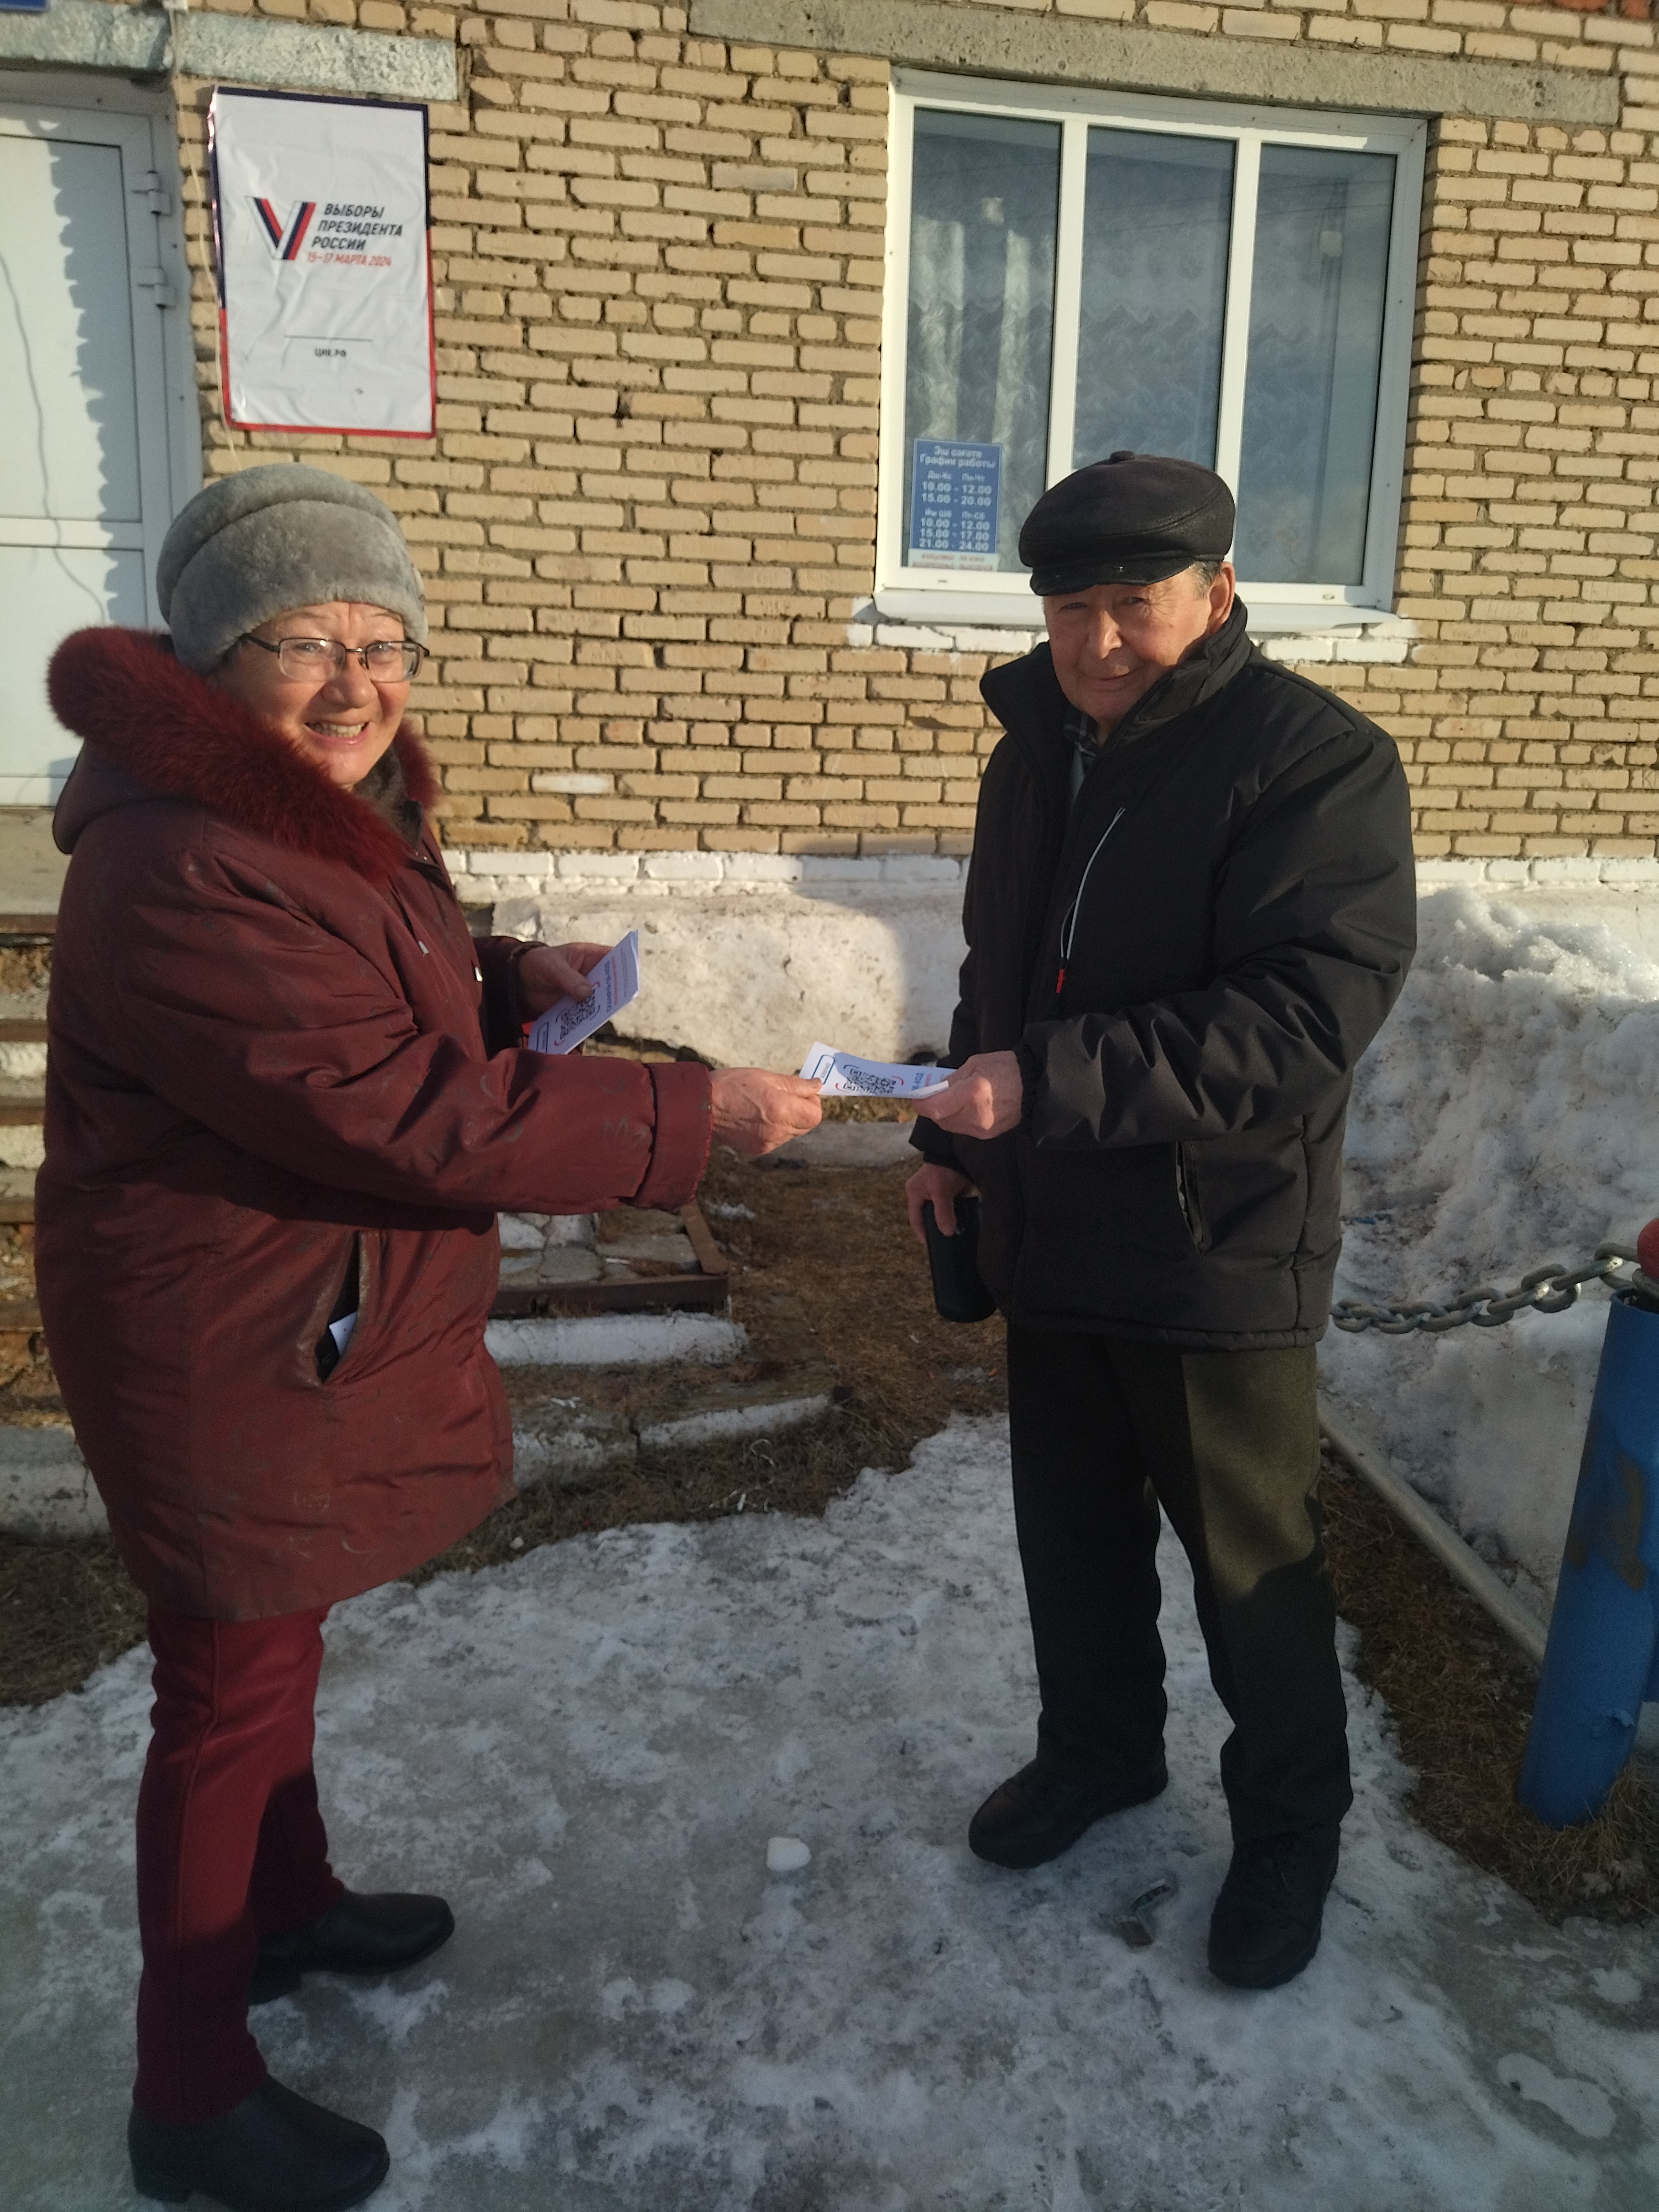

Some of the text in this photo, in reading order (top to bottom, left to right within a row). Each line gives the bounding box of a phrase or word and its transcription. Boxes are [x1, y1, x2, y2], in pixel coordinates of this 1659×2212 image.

[324, 203, 385, 218] ВЫБОРЫ
[317, 220, 403, 236] ПРЕЗИДЕНТА
[311, 236, 367, 251] РОССИИ
[335, 253, 367, 265] МАРТА
[368, 255, 392, 267] 2024
[314, 347, 347, 358] ЦИК.РФ
[958, 457, 995, 469] работы
[922, 481, 952, 493] 10.00
[962, 484, 993, 495] 12.00
[922, 492, 951, 504] 15.00
[961, 495, 992, 506] 20.00
[921, 517, 951, 528] 10.00
[961, 520, 991, 531] 12.00
[920, 528, 950, 539] 15.00
[960, 530, 990, 541] 17.00
[919, 538, 950, 550] 21.00
[958, 540, 989, 552] 24.00
